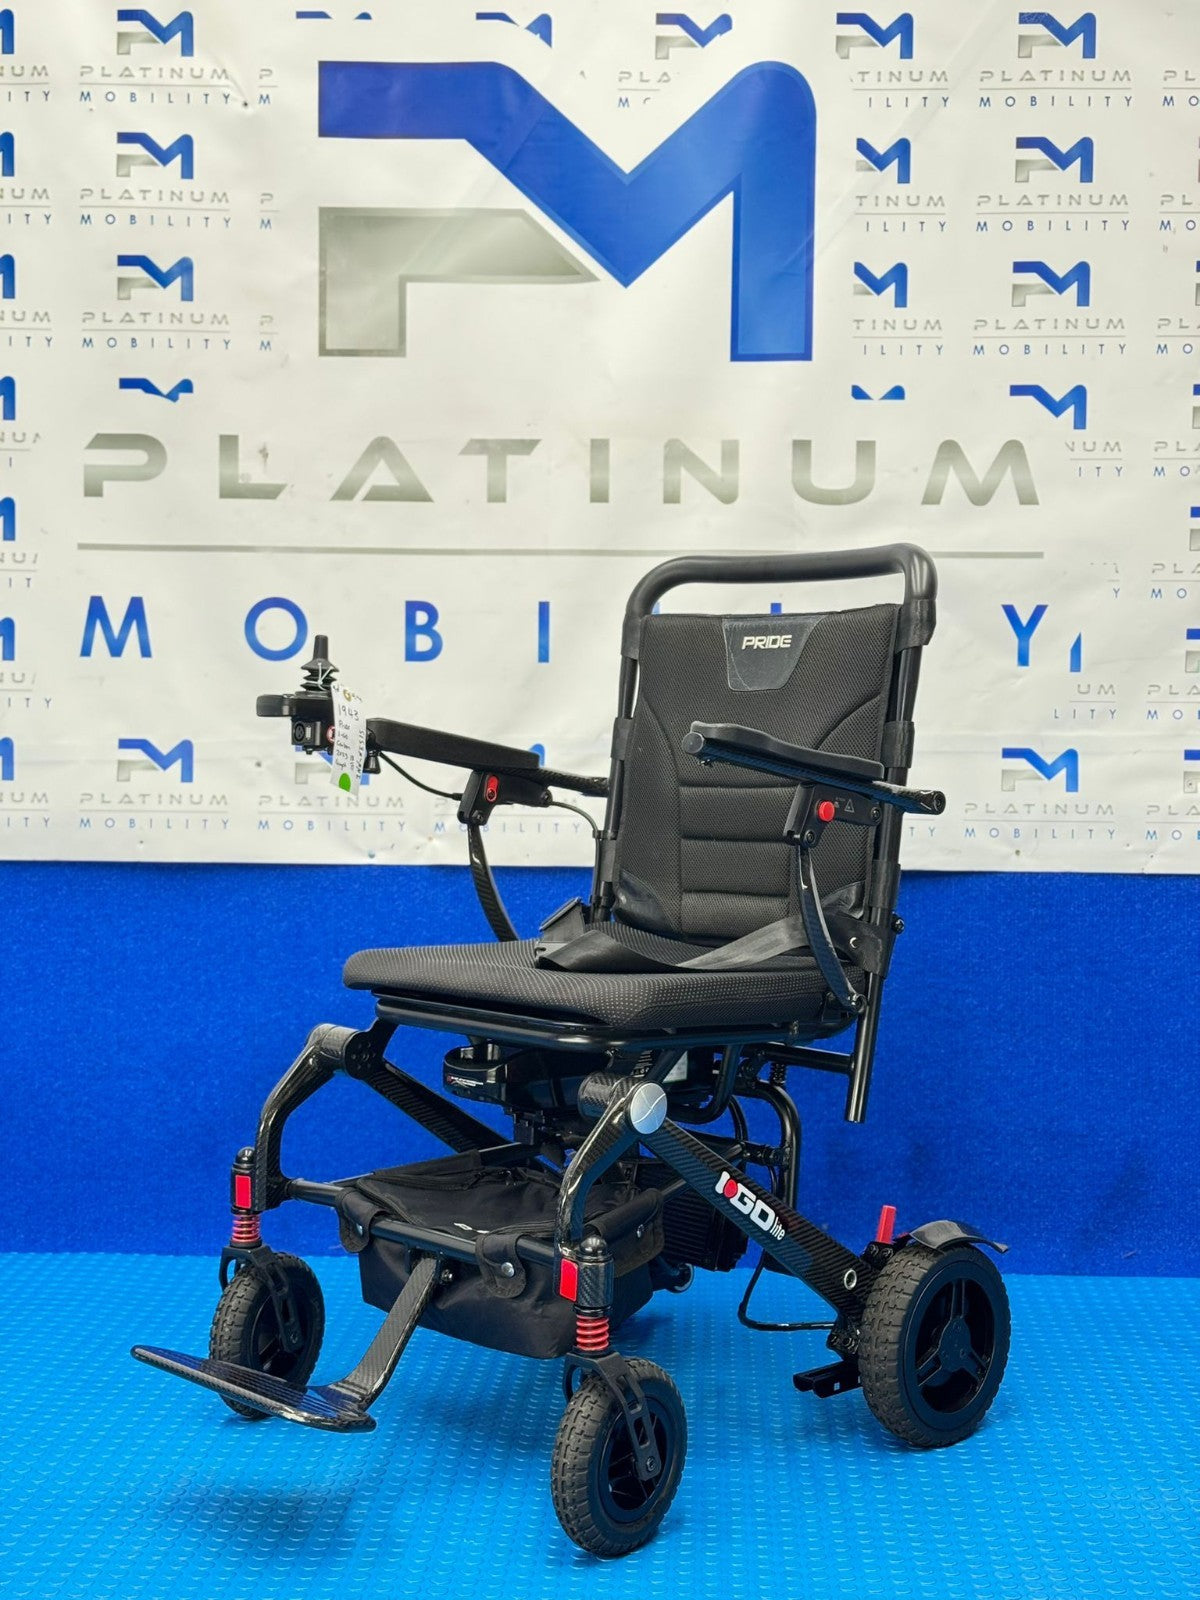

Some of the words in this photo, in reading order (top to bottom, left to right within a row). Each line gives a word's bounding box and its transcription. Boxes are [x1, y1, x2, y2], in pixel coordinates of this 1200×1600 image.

[80, 65, 229, 80] PLATINUM
[618, 71, 671, 83] PLA
[850, 70, 948, 82] TINUM
[980, 70, 1131, 82] PLATINUM
[79, 91, 230, 104] MOBILITY
[979, 96, 1132, 107] MOBILITY
[80, 188, 229, 203] PLATINUM
[977, 194, 1128, 206] PLATINUM
[80, 214, 231, 227] MOBILITY
[976, 220, 1129, 231] MOBILITY
[82, 312, 229, 325] PLATINUM
[974, 318, 1125, 330] PLATINUM
[1158, 318, 1200, 329] PL
[82, 337, 230, 349] MOBILITY
[973, 344, 1126, 355] MOBILITY
[83, 433, 1039, 506] PLATINUM
[80, 596, 1048, 667] MOBIY
[742, 635, 792, 650] PRIDE
[1147, 709, 1200, 720] MO
[79, 793, 228, 806] PLATINUM
[258, 795, 404, 808] PLATINUM
[965, 803, 1114, 815] PLATINUM
[79, 817, 228, 829] MOBILITY
[258, 820, 405, 832] MOBILITY
[965, 825, 1115, 839] MOBILITY
[1146, 830, 1200, 840] MO
[770, 1217, 785, 1240] lite
